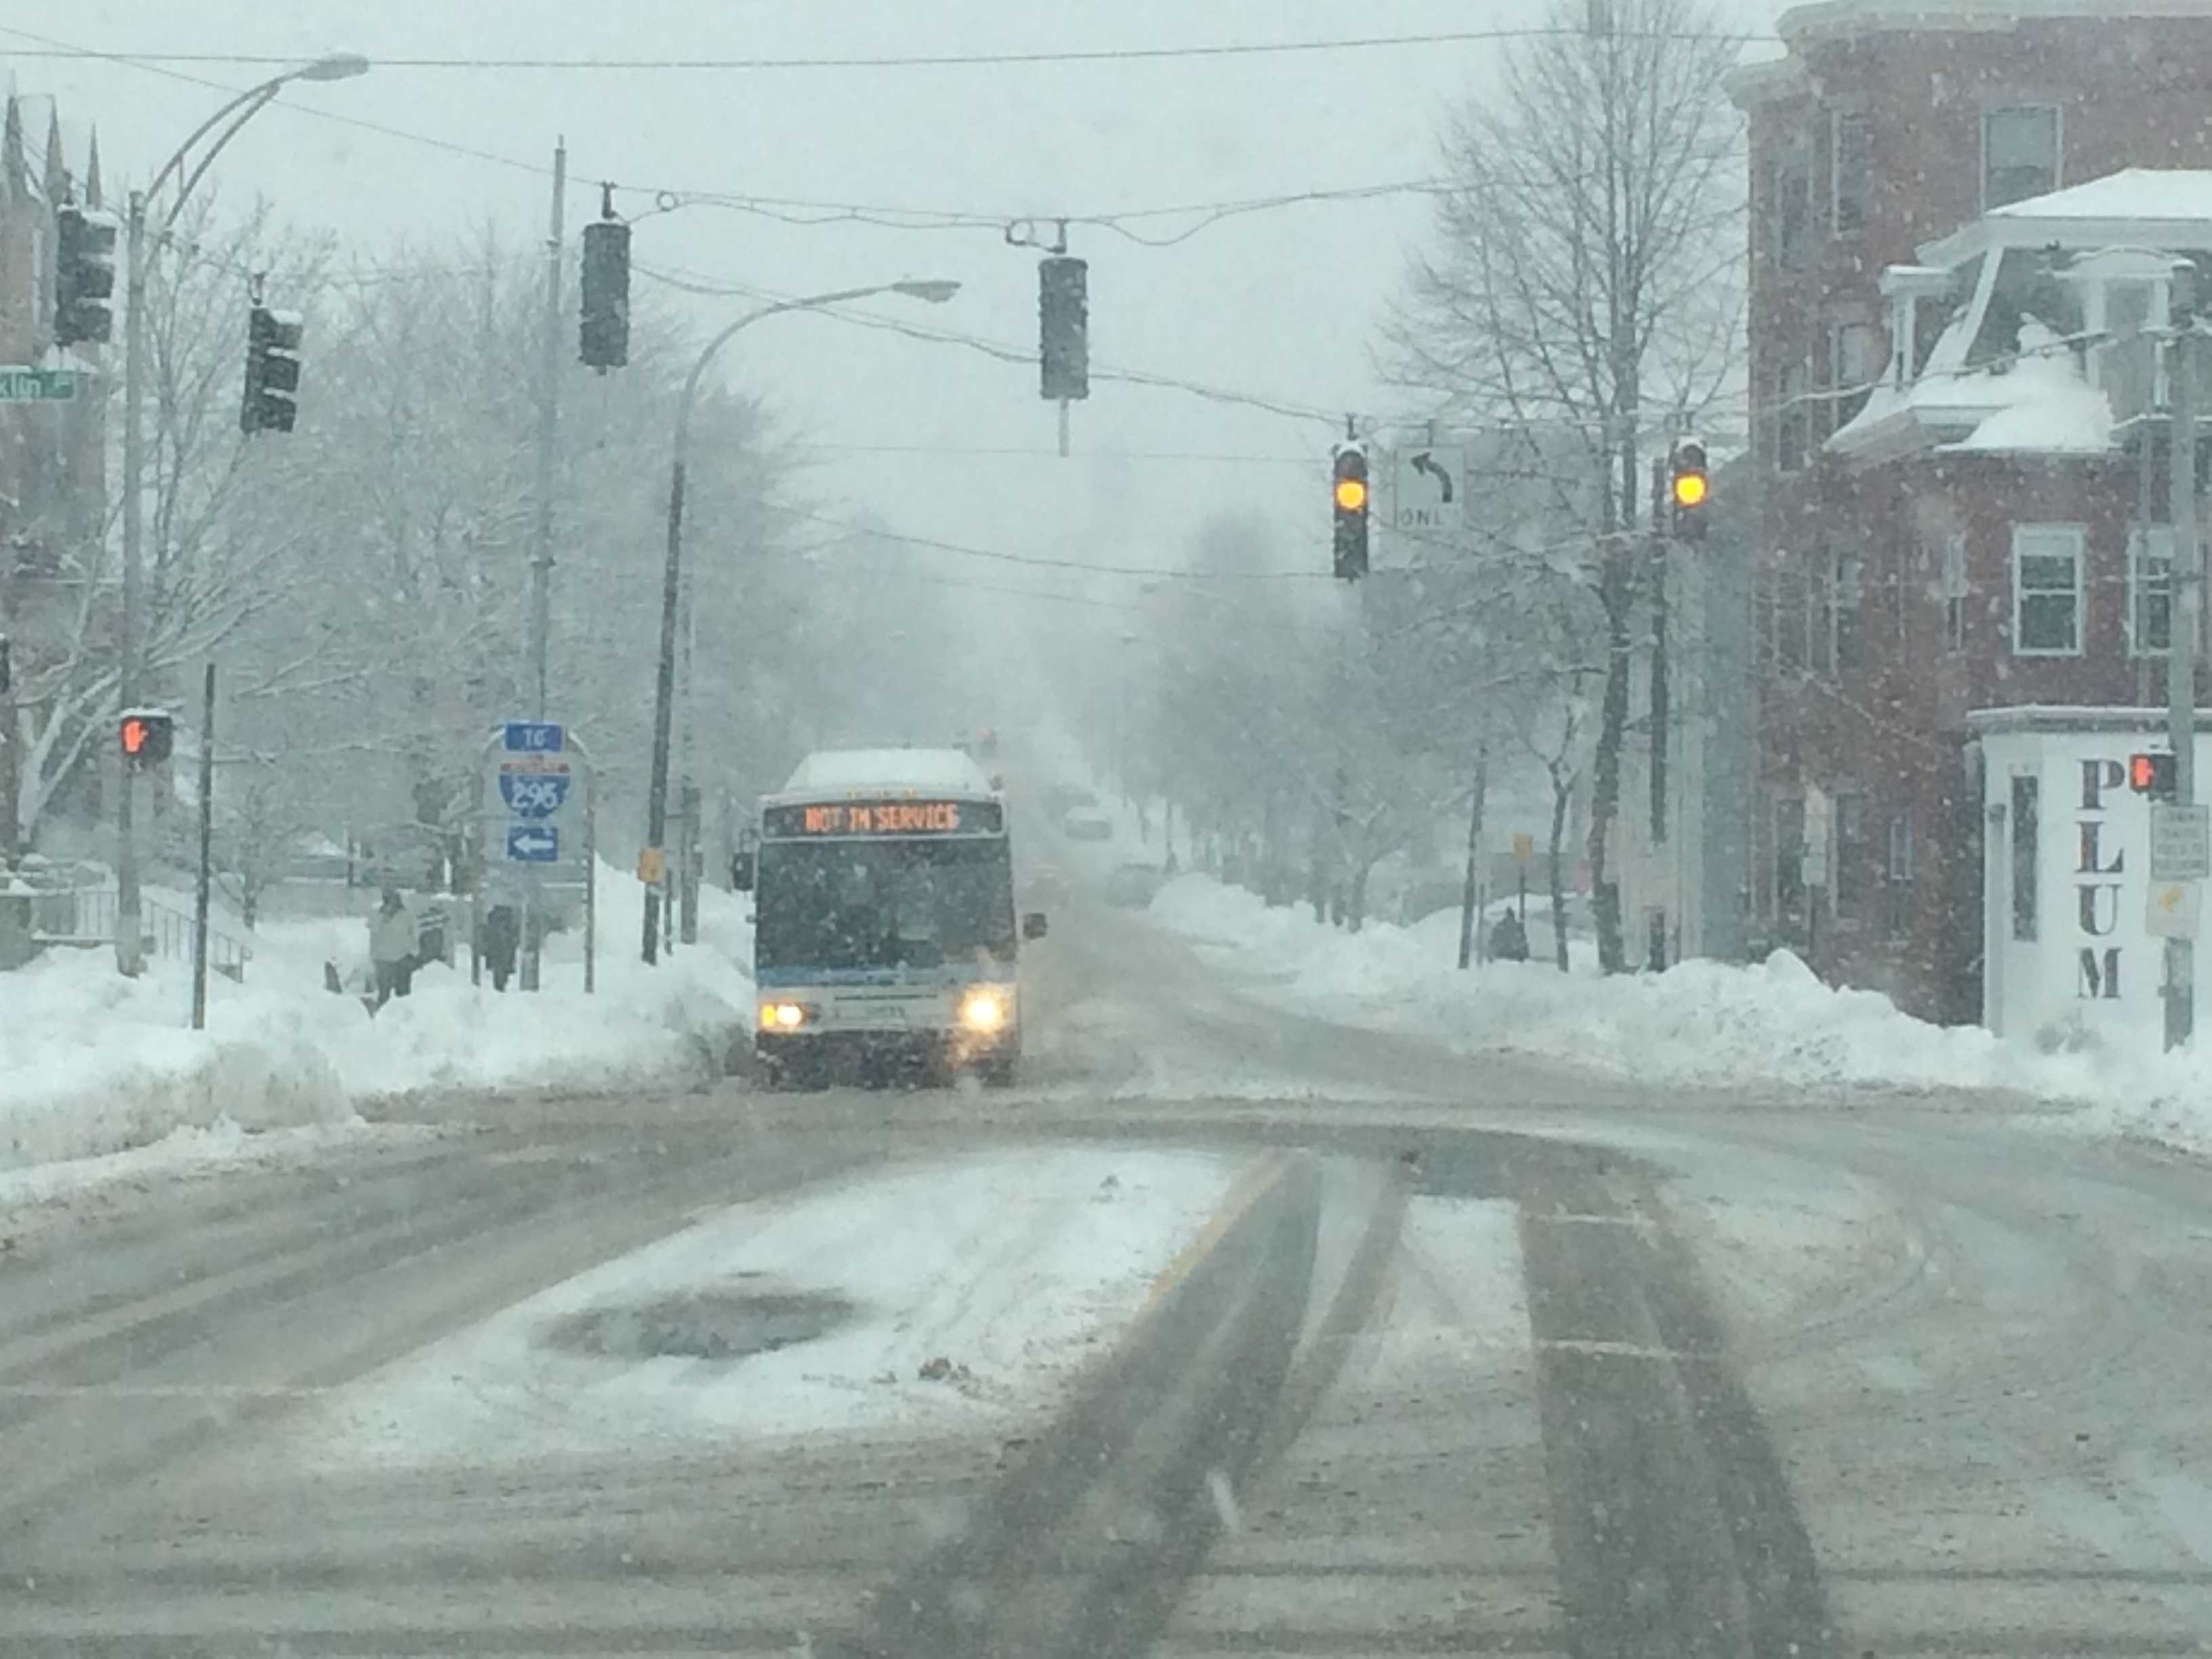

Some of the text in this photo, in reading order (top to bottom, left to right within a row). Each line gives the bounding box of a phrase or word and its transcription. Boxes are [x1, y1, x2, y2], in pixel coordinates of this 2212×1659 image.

[1400, 508, 1454, 526] ONL
[805, 803, 960, 832] NOT IN SERVICE
[2074, 758, 2125, 999] PLUM
